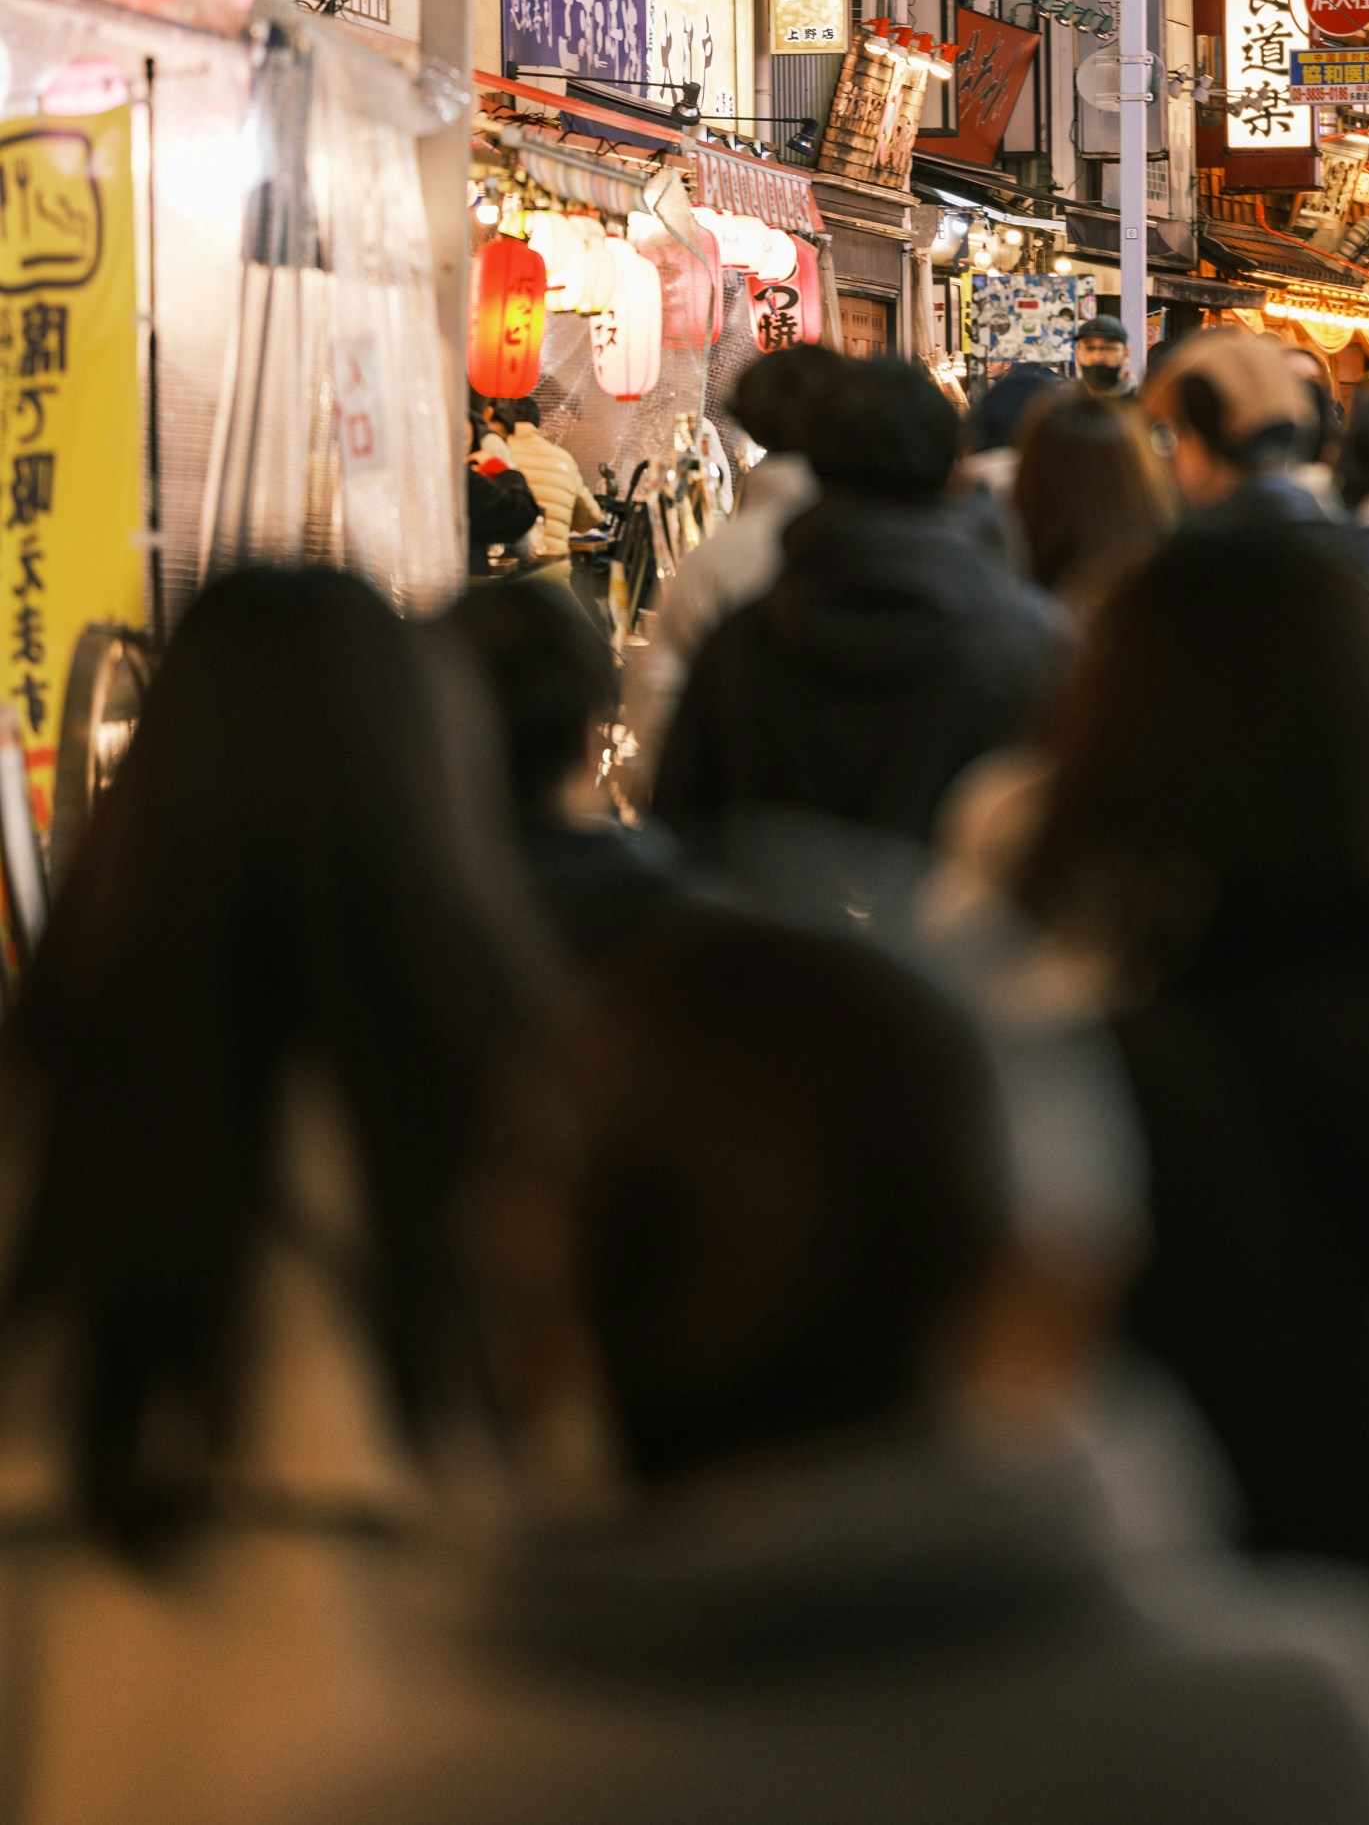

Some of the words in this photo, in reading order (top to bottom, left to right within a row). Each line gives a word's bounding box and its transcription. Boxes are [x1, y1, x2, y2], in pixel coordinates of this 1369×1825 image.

[787, 28, 835, 41] 上野店
[754, 264, 799, 349] つ焼
